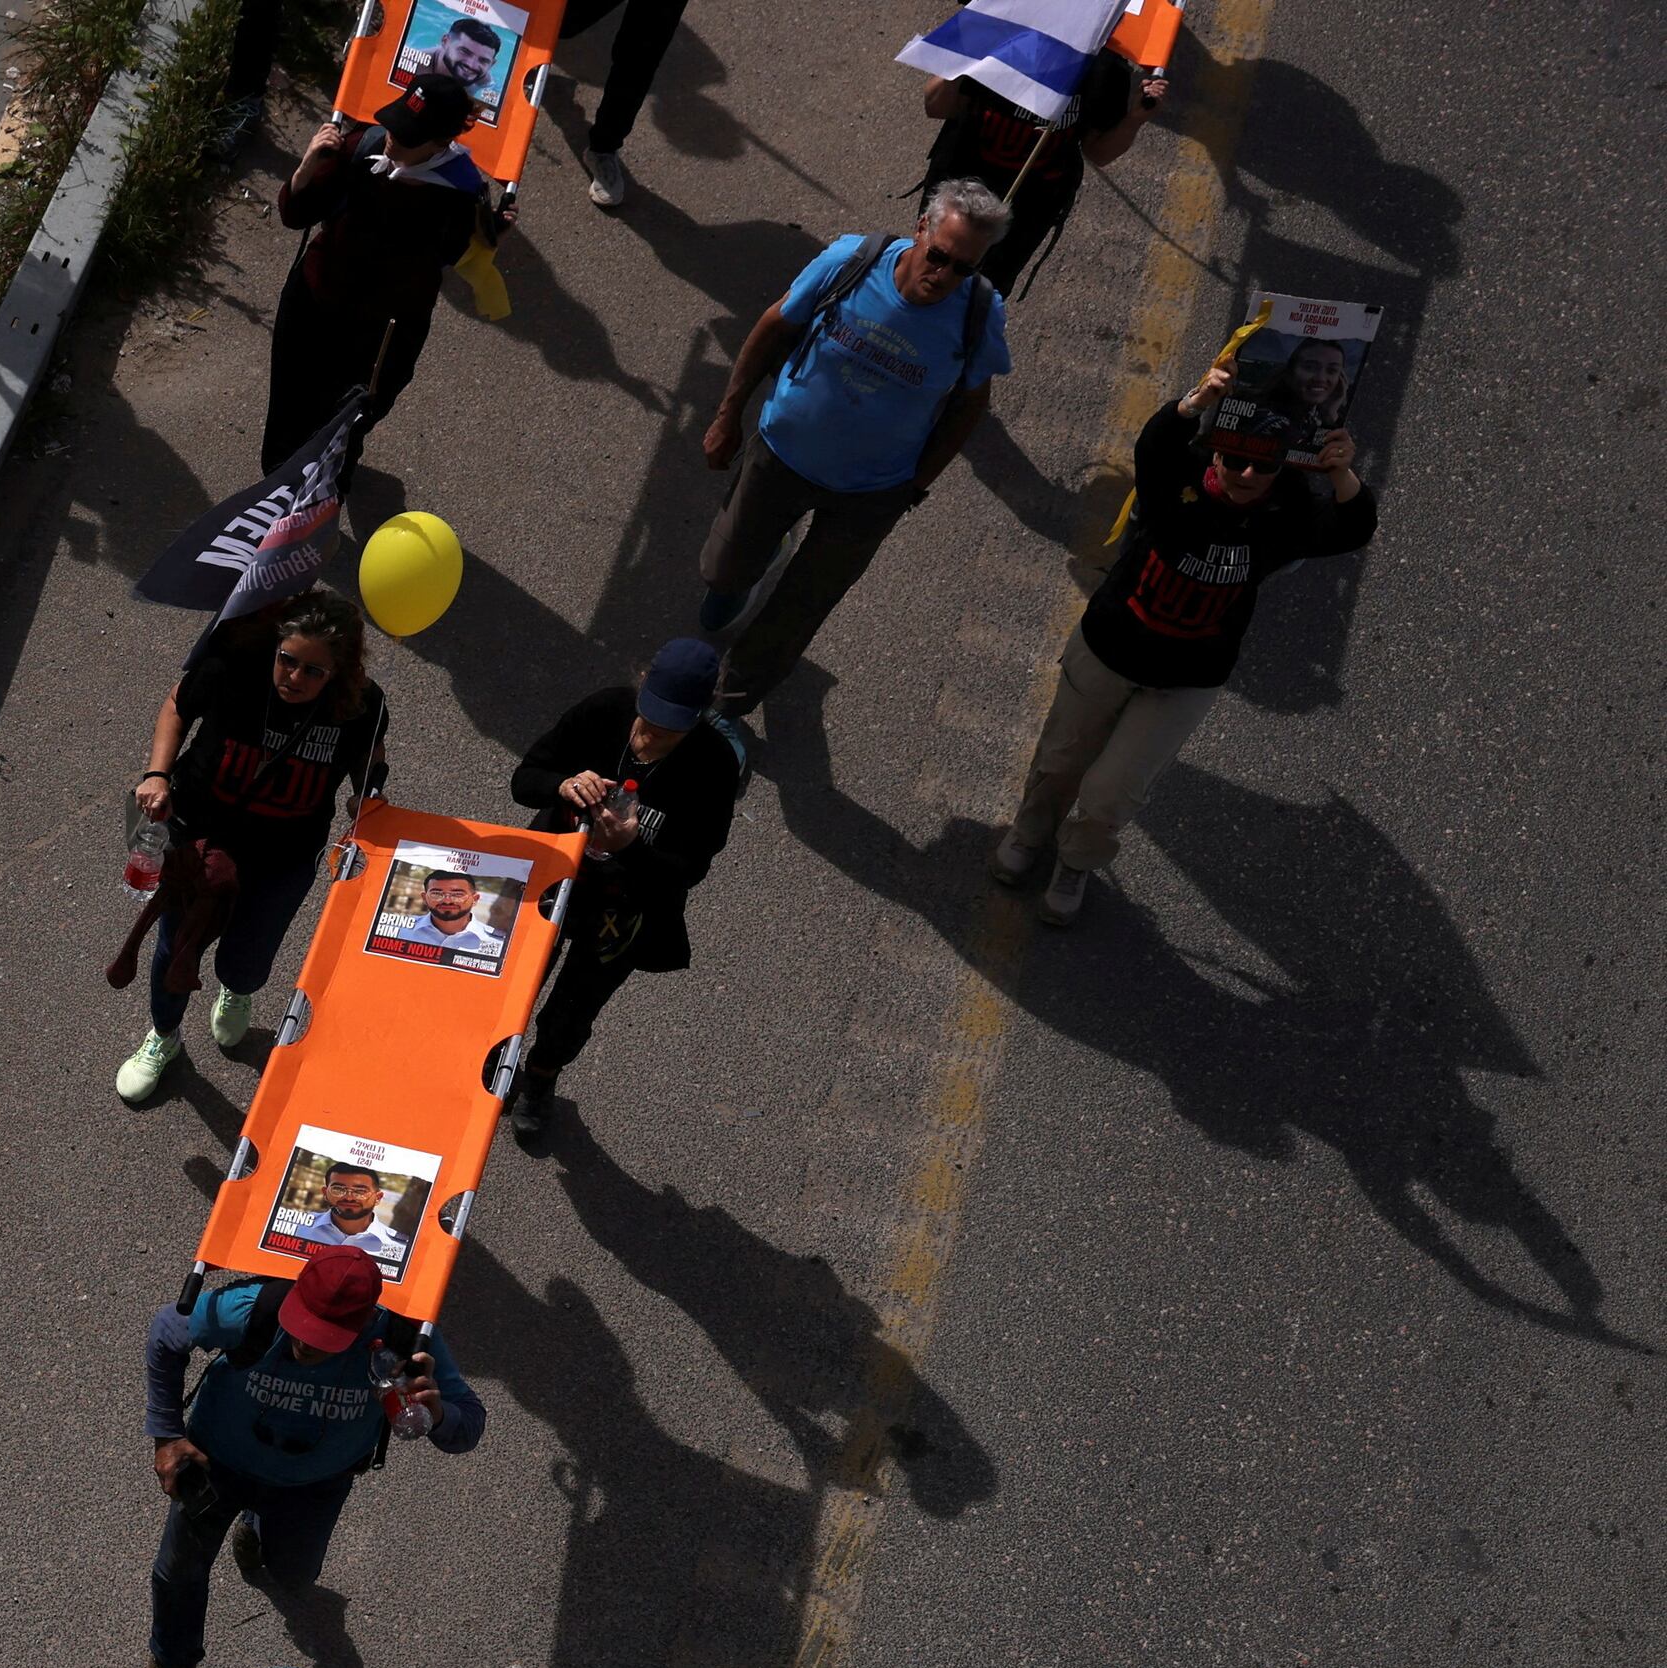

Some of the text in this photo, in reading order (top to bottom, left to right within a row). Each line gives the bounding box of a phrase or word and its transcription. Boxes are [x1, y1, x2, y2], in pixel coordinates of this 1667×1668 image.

[397, 57, 417, 74] HIM
[401, 47, 432, 67] BRING
[885, 356, 929, 386] OZARKS
[1220, 398, 1257, 418] BRING
[1216, 413, 1240, 431] HER
[1207, 544, 1250, 565] מחזירים
[1216, 564, 1250, 584] אותם
[446, 857, 461, 865] RAN
[379, 912, 416, 928] BRING
[375, 924, 400, 937] HIM
[372, 937, 443, 959] HOME NOW!
[350, 1148, 385, 1161] RAN GVILI
[357, 1158, 373, 1167] (24)
[276, 1207, 315, 1227] BRING
[272, 1220, 297, 1236] HIM
[268, 1234, 302, 1252] HOME
[247, 1370, 369, 1404] #BRING THEM
[245, 1381, 366, 1421] HOME NOW!
